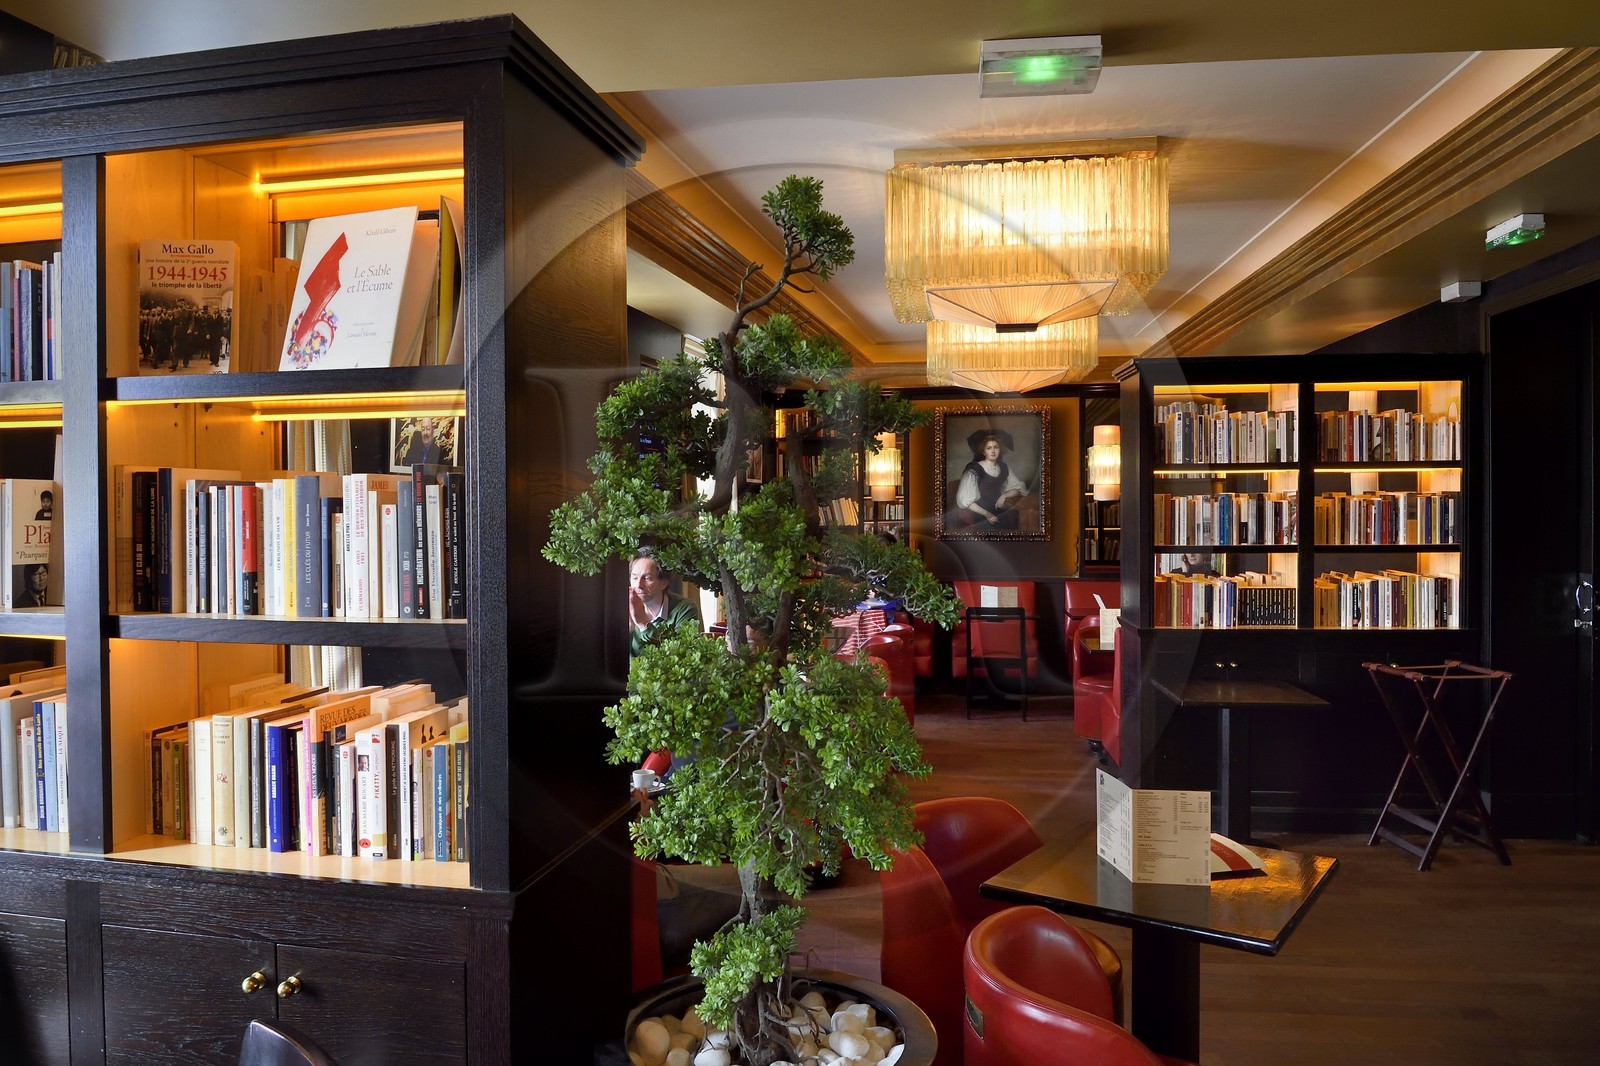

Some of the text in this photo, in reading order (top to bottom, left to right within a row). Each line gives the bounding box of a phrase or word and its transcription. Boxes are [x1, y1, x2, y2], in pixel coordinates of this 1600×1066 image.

[1493, 232, 1509, 247] SORTIE
[162, 244, 214, 254] Max Gallo
[148, 265, 228, 282] 1944-1945
[355, 264, 392, 278] Le Sable
[347, 279, 393, 293] et l'Écume
[371, 481, 389, 490] JAMES
[303, 531, 311, 549] FUTUR
[416, 549, 424, 584] INCINÉRATION
[304, 573, 312, 583] LES
[320, 705, 356, 723] REVUE DES
